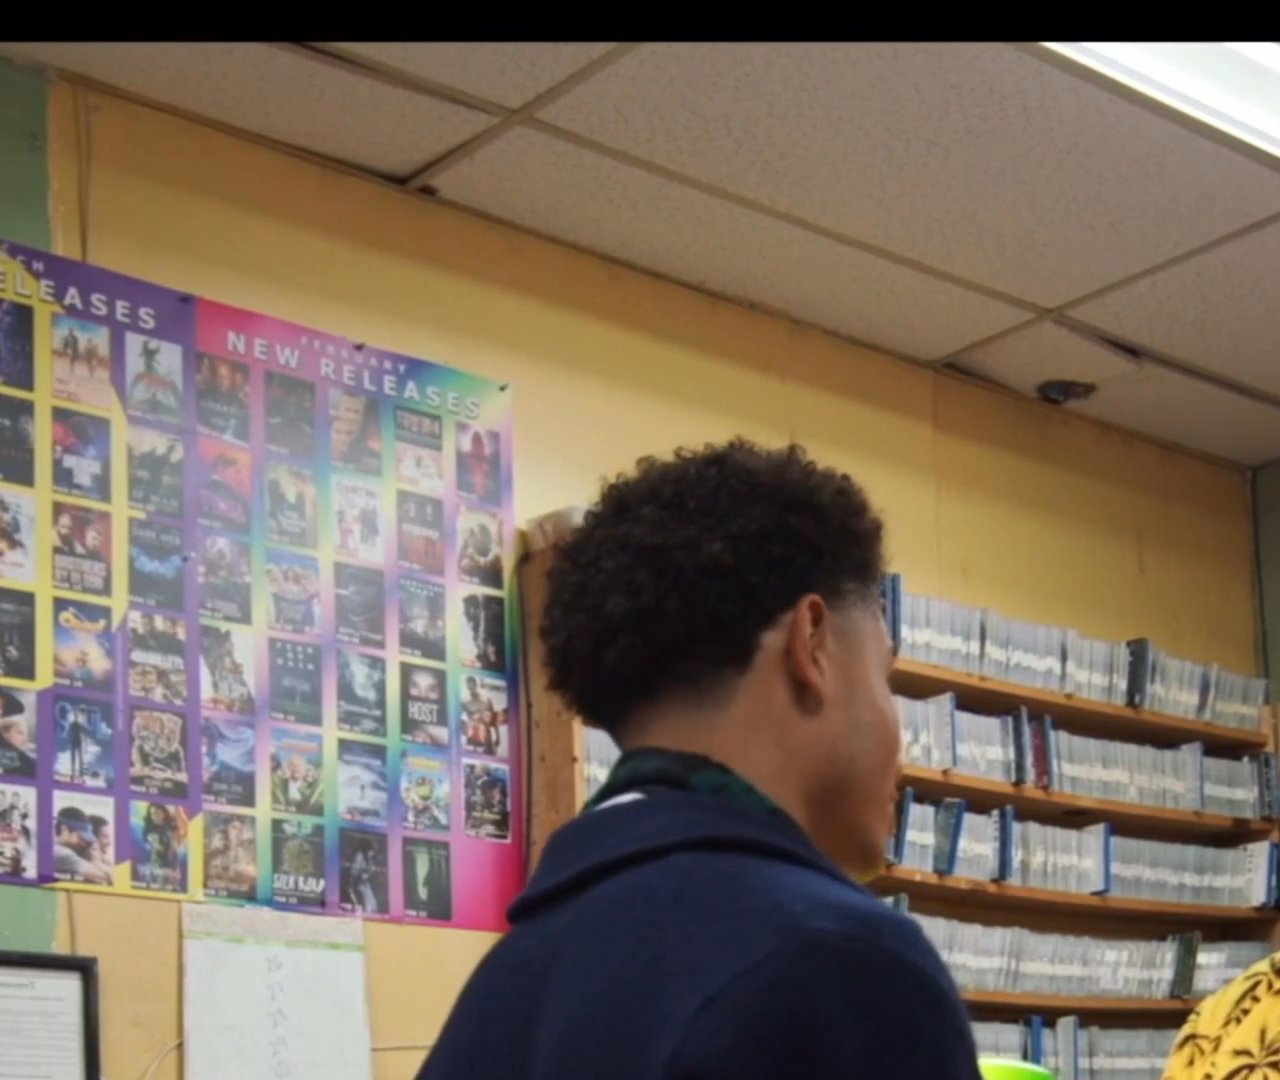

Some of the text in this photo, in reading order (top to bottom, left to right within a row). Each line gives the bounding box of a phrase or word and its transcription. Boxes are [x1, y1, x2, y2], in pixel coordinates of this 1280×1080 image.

[302, 336, 407, 373] FEBRUARY
[227, 331, 479, 419] NEW RELEASES
[408, 701, 438, 723] HOST
